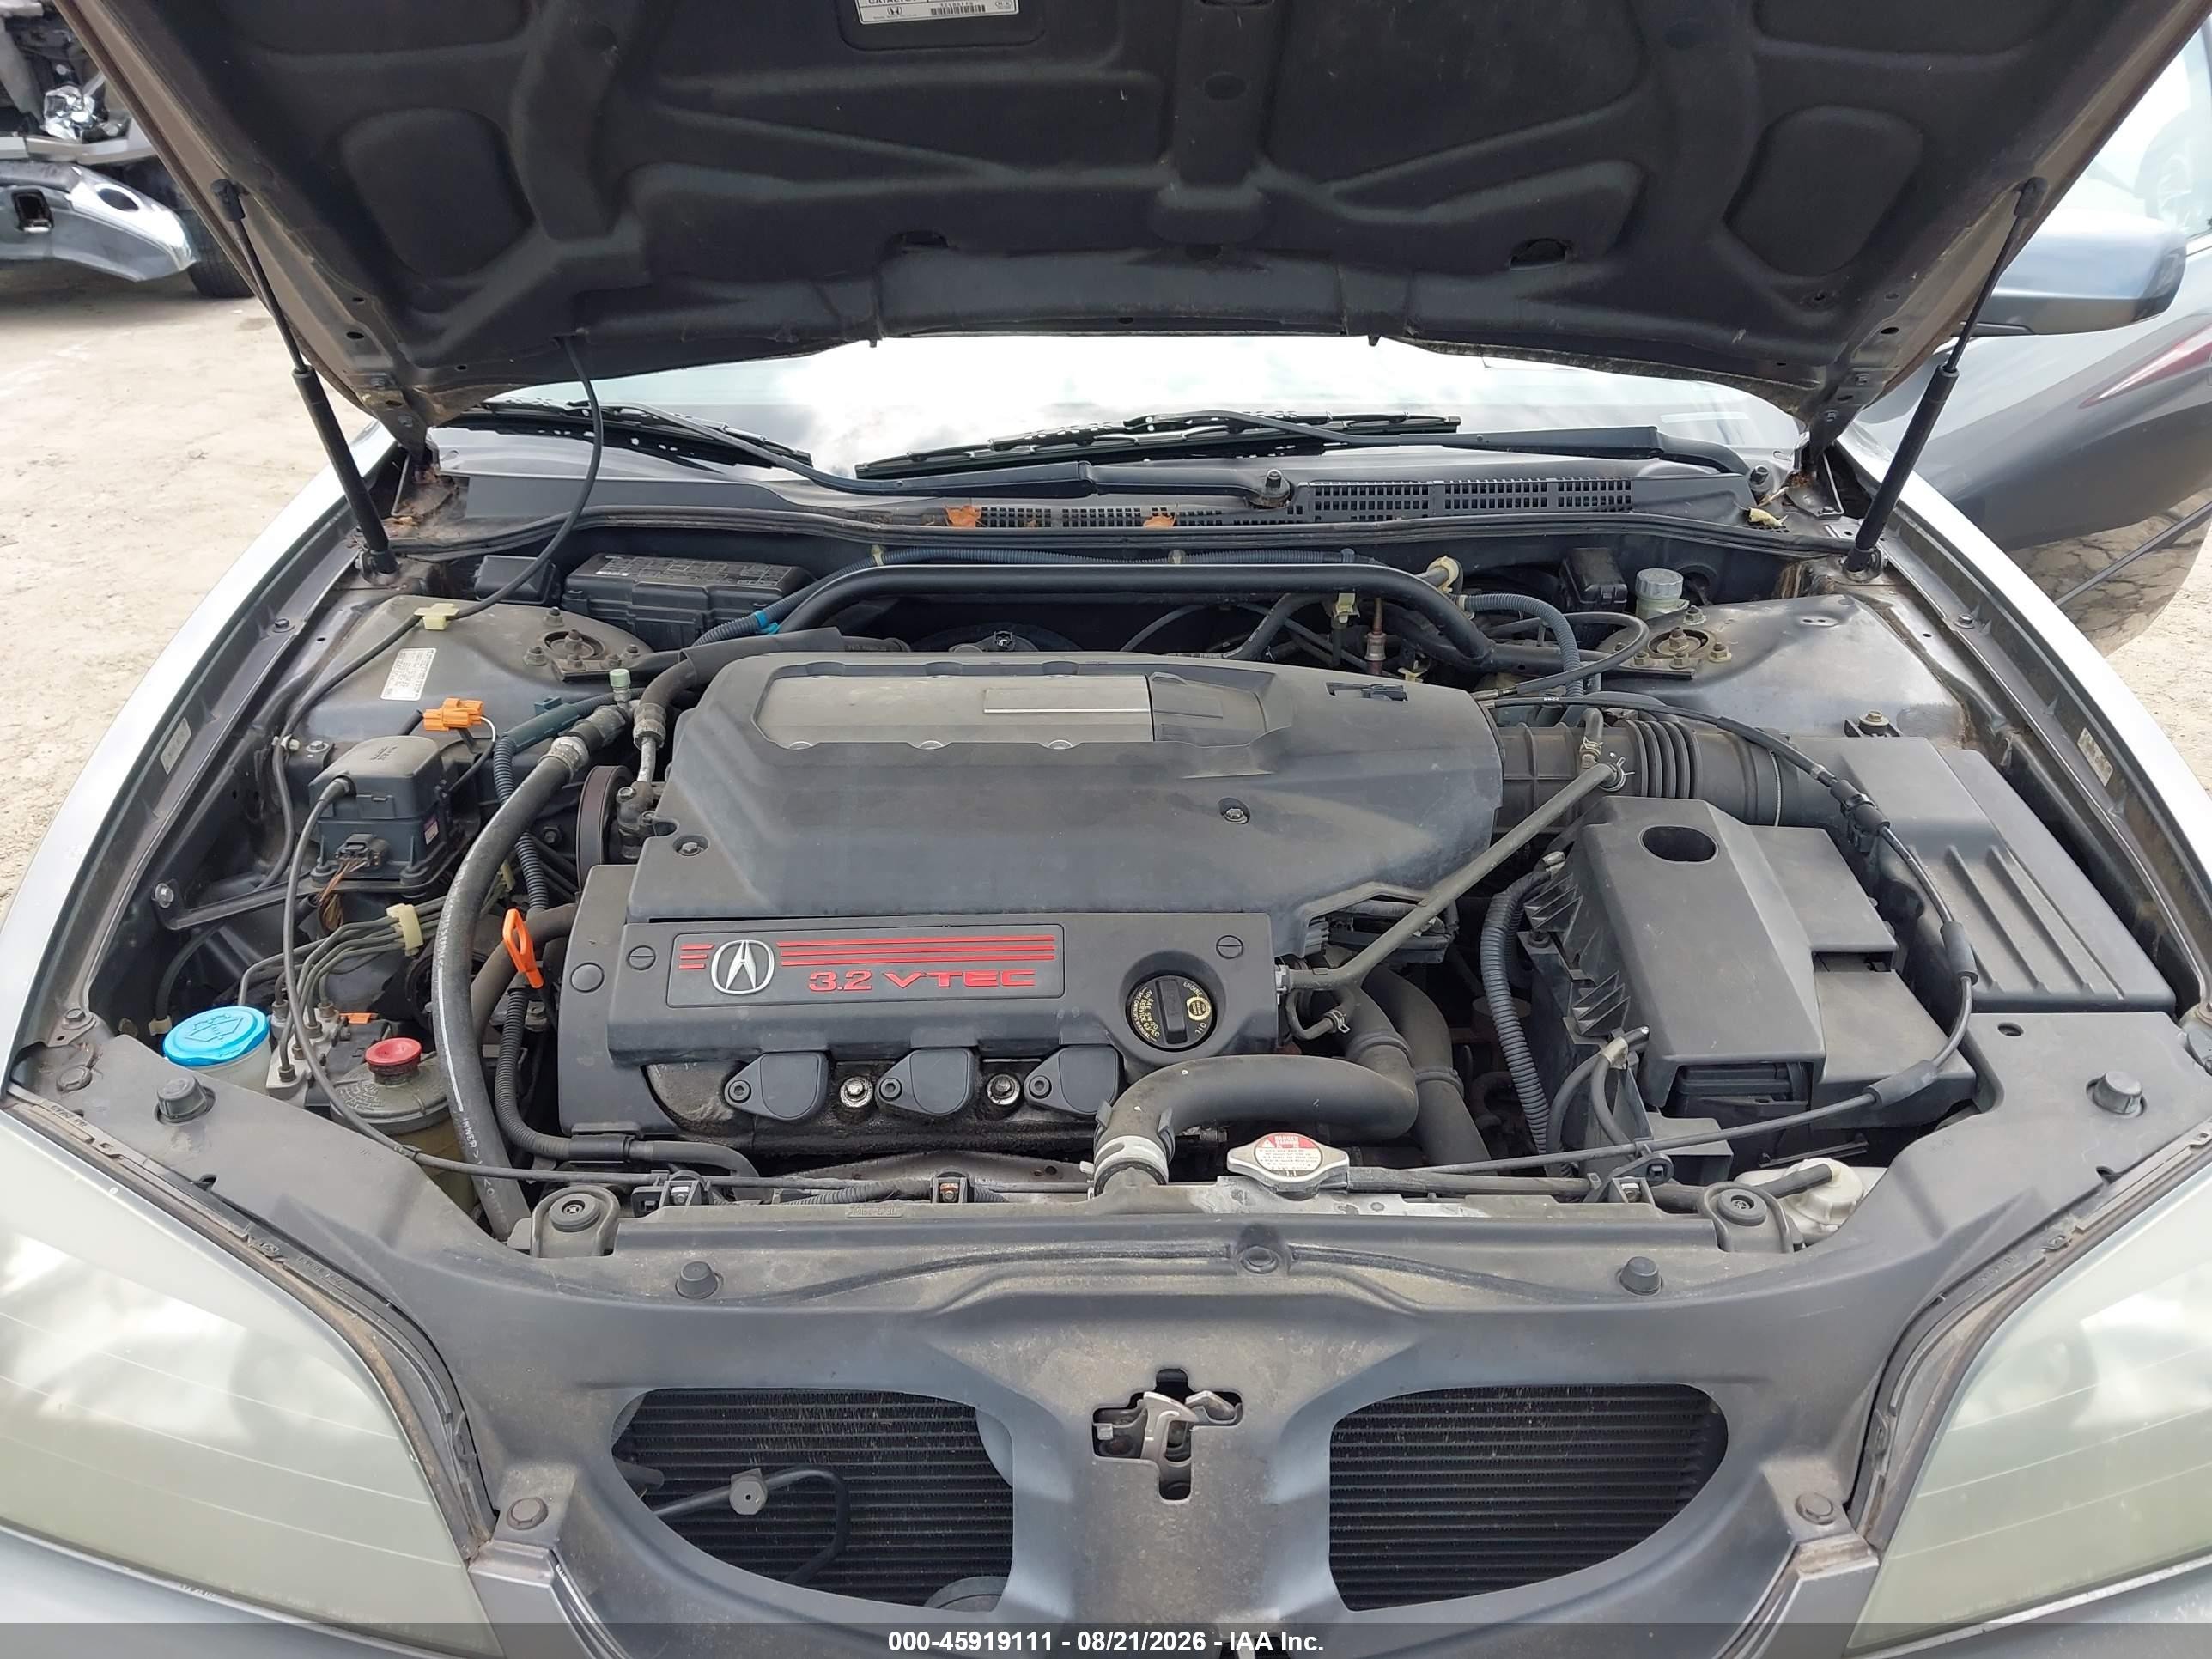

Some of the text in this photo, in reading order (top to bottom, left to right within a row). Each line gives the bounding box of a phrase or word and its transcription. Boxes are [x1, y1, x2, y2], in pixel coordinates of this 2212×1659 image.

[809, 969, 1035, 991] 3.2 VTEC
[1183, 981, 1203, 996] ENGINE
[1195, 1023, 1206, 1035] OIL
